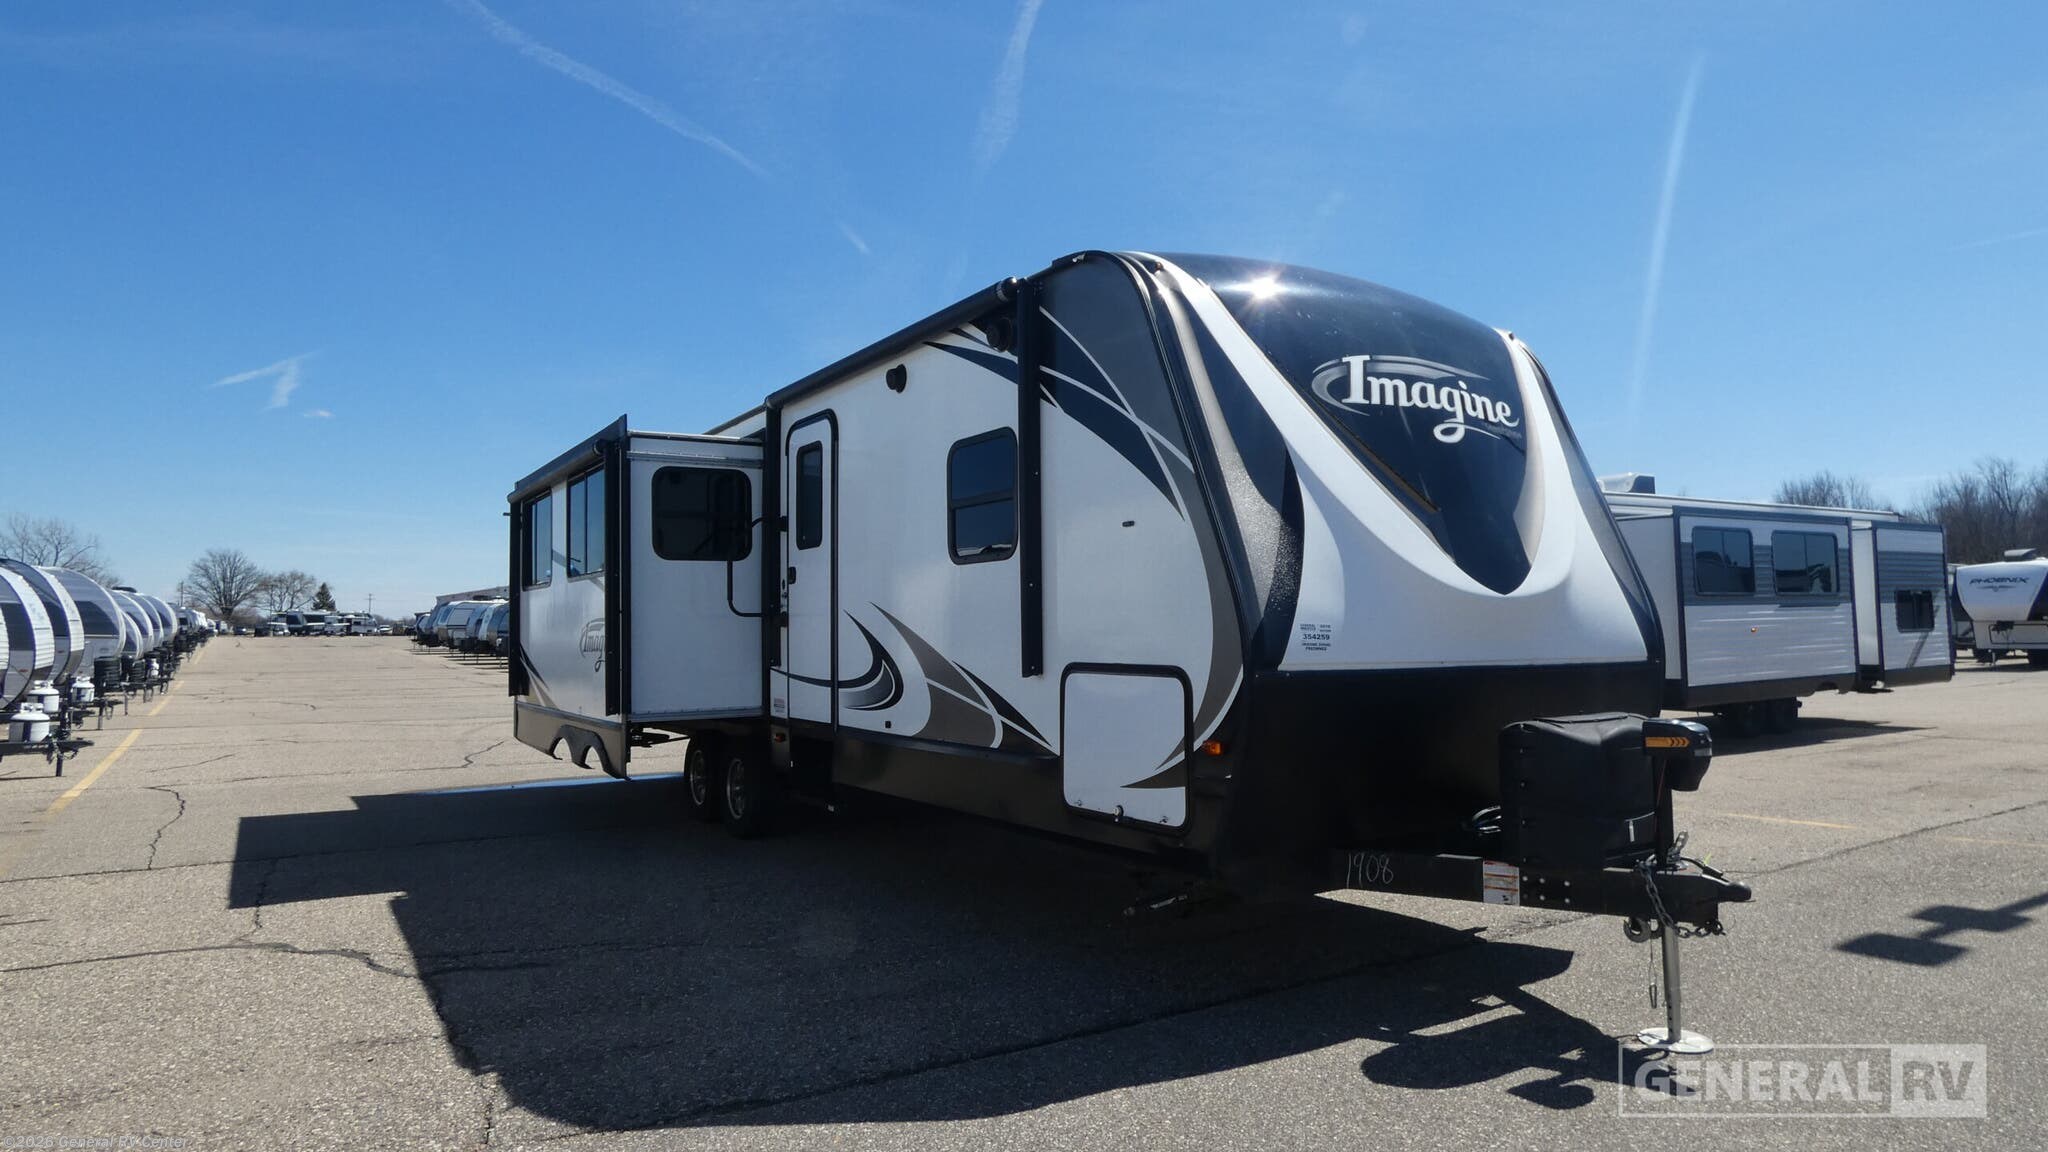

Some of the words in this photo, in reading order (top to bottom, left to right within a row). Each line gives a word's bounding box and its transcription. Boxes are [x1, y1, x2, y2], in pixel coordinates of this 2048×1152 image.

[1341, 354, 1520, 444] Imagine
[1970, 577, 2029, 585] PHOENIX
[1346, 852, 1394, 889] 1908
